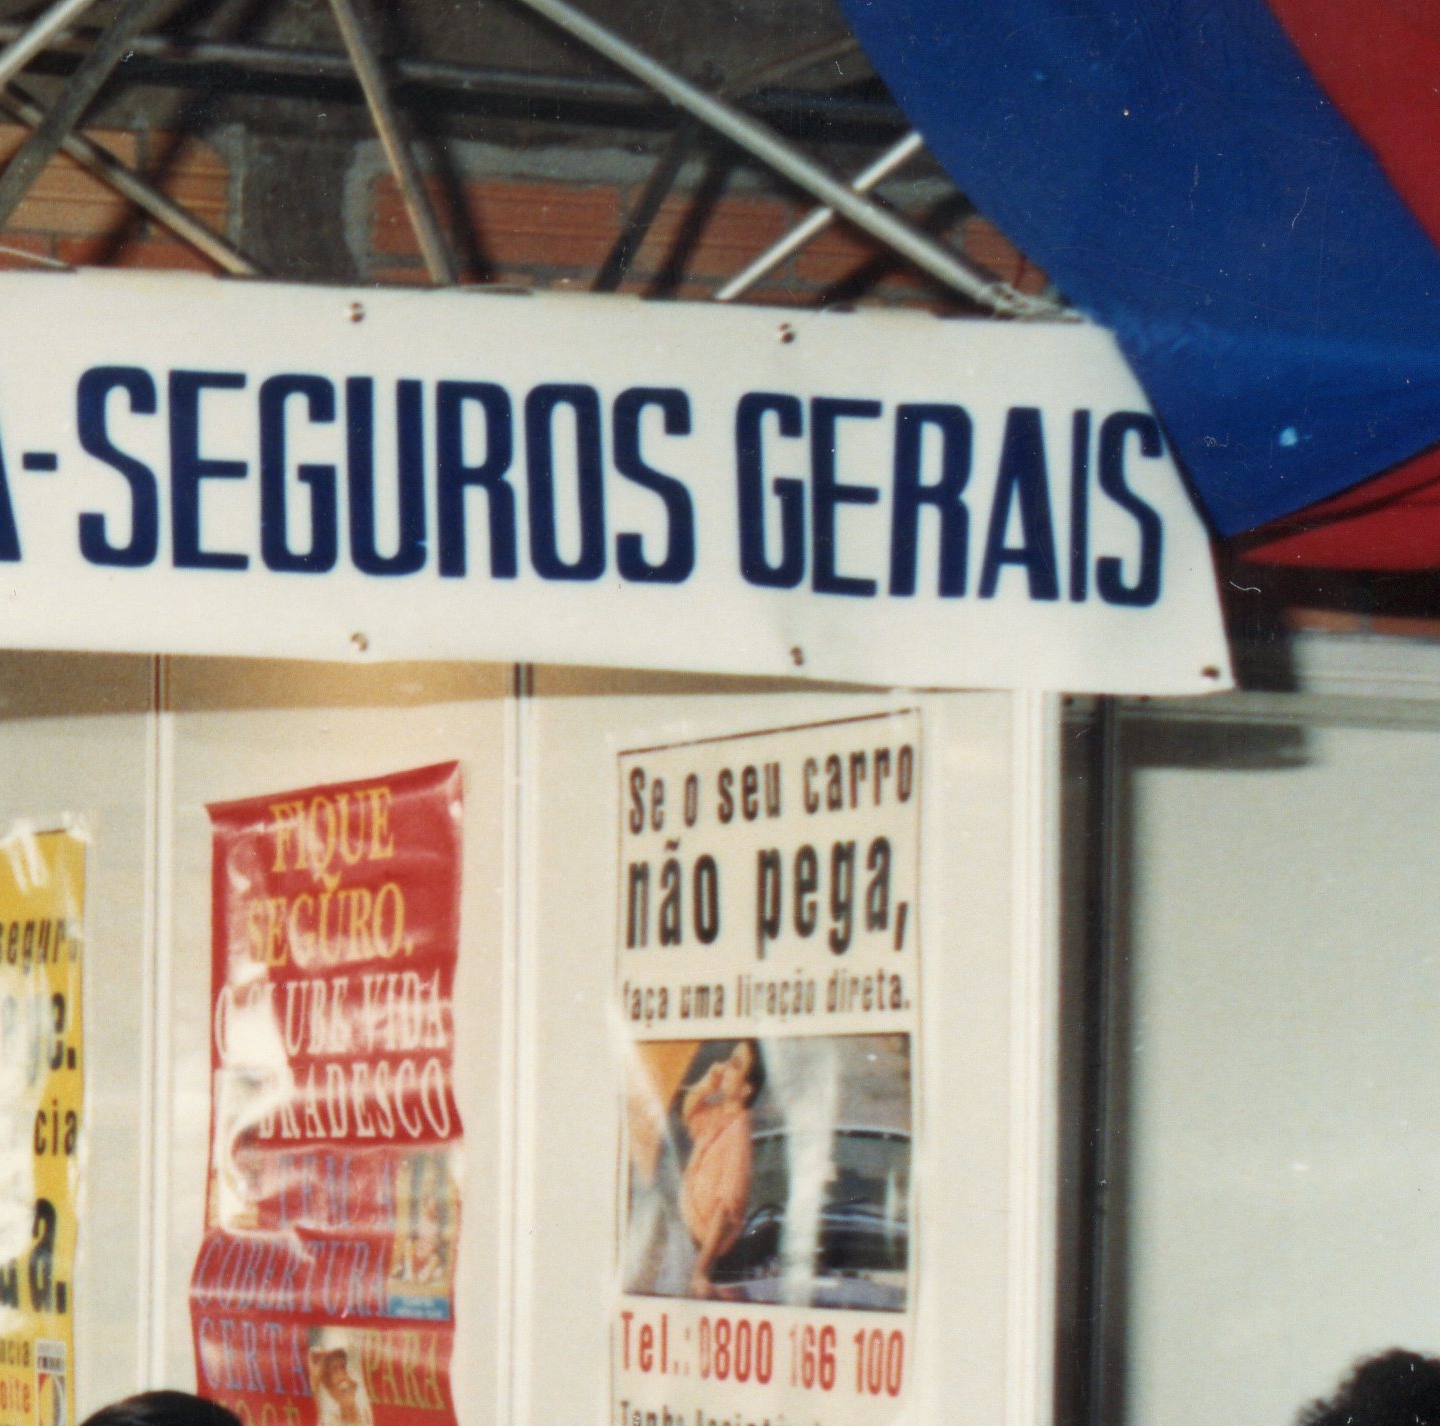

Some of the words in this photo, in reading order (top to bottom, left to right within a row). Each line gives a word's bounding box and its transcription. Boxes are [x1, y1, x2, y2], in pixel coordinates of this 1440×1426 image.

[735, 391, 1164, 608] GERAIS
[628, 766, 666, 836] Se
[683, 772, 699, 829] o
[717, 761, 781, 825] seu
[802, 744, 914, 816] carro
[269, 786, 394, 890] FIQUE
[247, 881, 415, 969] SEGURO.
[626, 837, 720, 950] não
[755, 835, 909, 962] pega,
[361, 968, 447, 1052] VIDA
[680, 983, 725, 1020] uma
[196, 1235, 391, 1317] COBERTURA
[198, 1316, 313, 1398] CERTA
[362, 1327, 448, 1411] PARA
[699, 1315, 774, 1386] 0800
[788, 1323, 838, 1392] 166
[853, 1327, 906, 1398] 100
